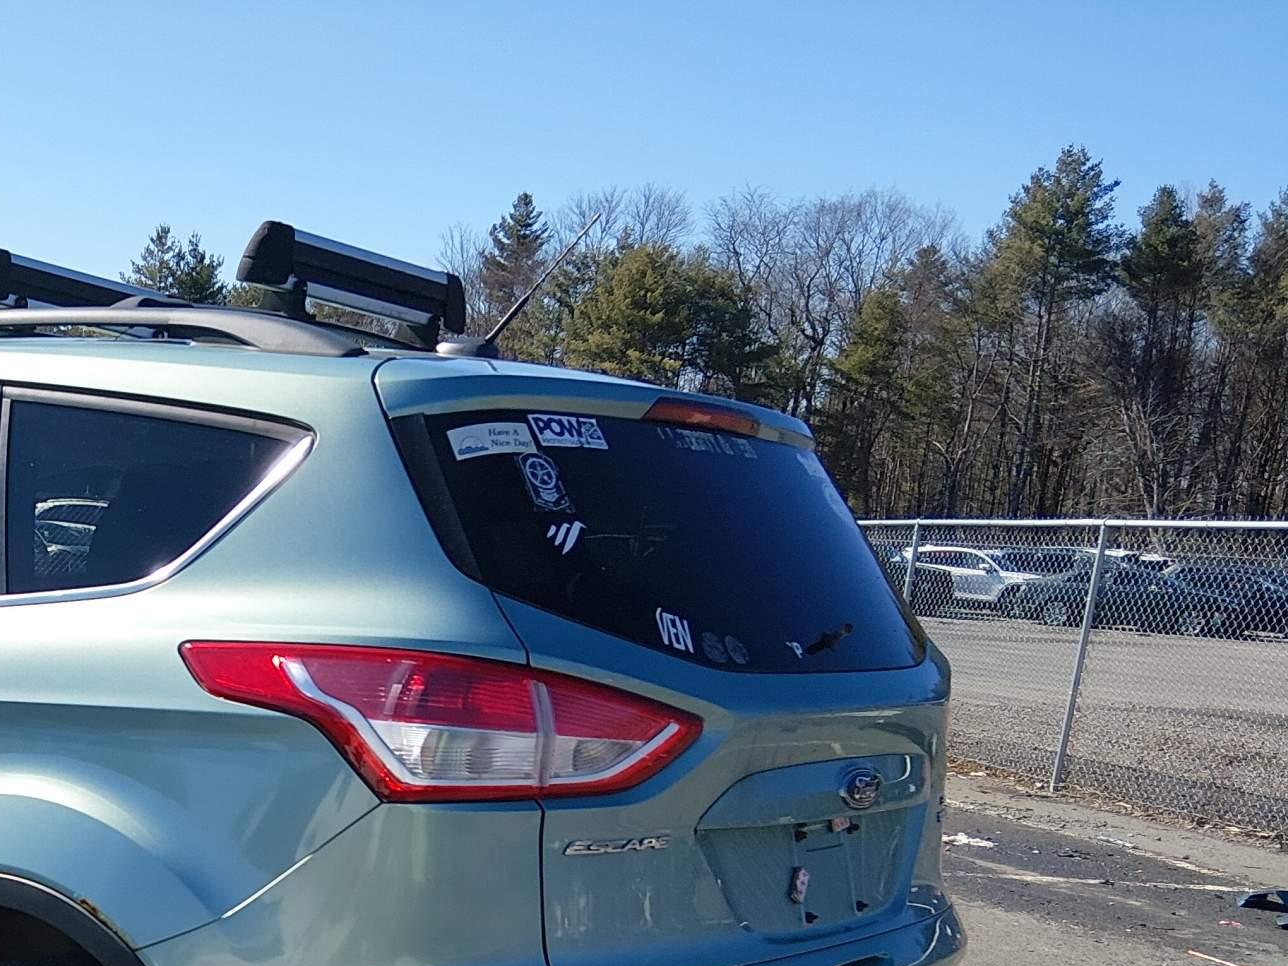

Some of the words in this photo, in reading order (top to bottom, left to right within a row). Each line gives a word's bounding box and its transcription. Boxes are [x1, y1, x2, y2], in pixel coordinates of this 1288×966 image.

[488, 428, 511, 437] Have
[512, 428, 520, 437] A
[490, 439, 511, 448] Nice
[563, 835, 671, 856] ESCAPE
